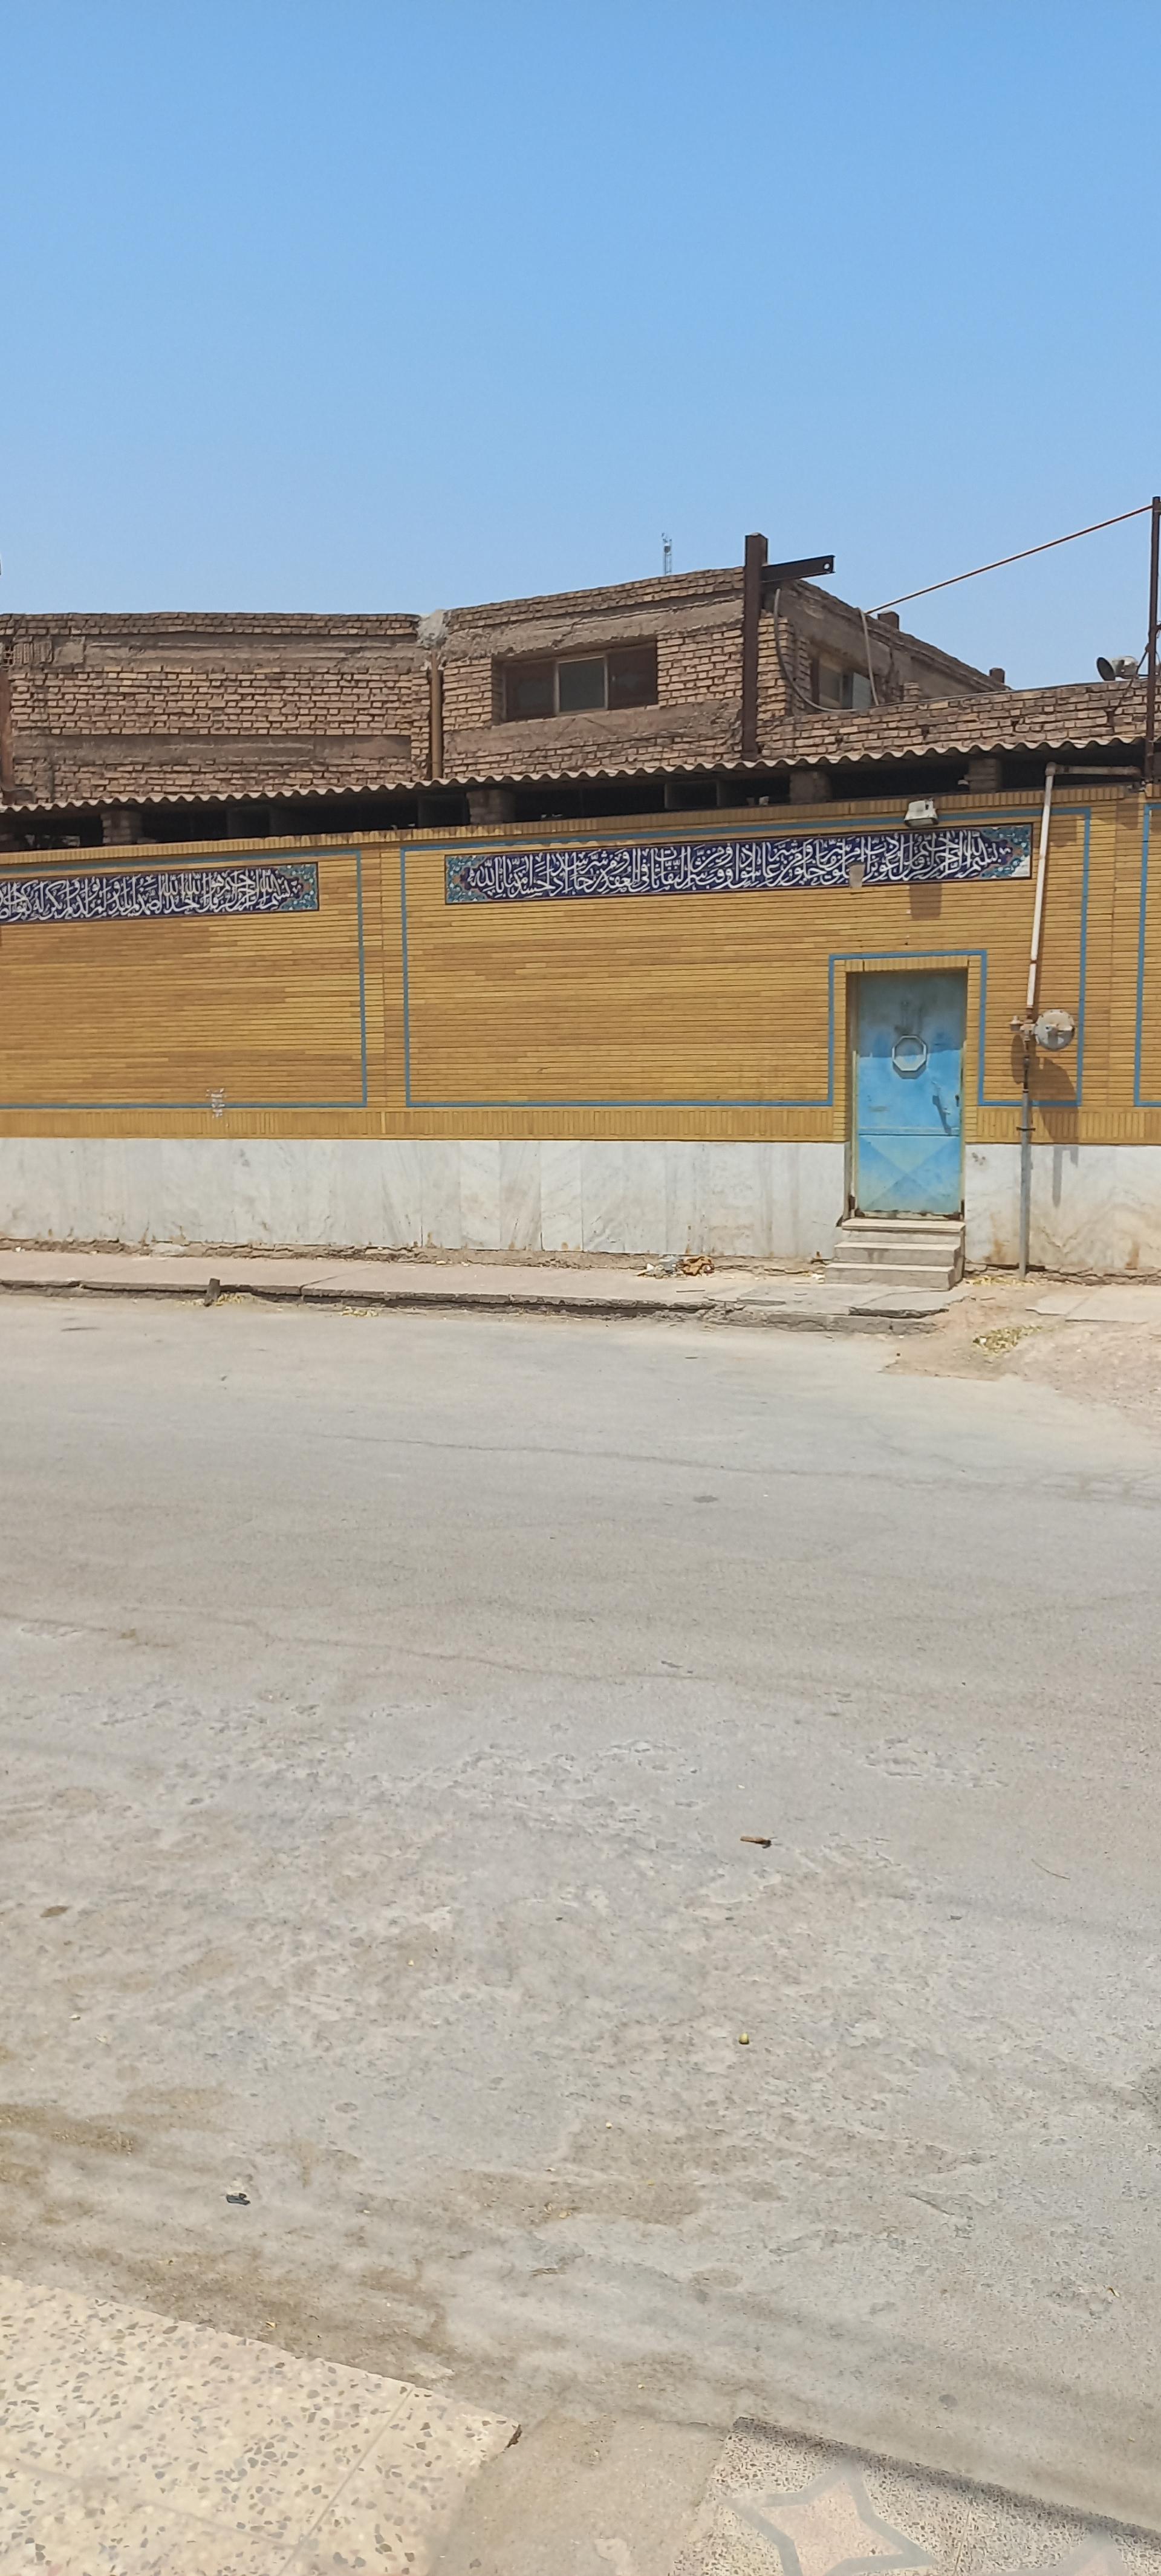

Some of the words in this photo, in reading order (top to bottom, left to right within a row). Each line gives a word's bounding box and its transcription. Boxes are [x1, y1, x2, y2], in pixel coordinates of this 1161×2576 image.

[914, 831, 971, 879] الرحمن
[954, 842, 1000, 879] بسم
[963, 831, 987, 864] الله
